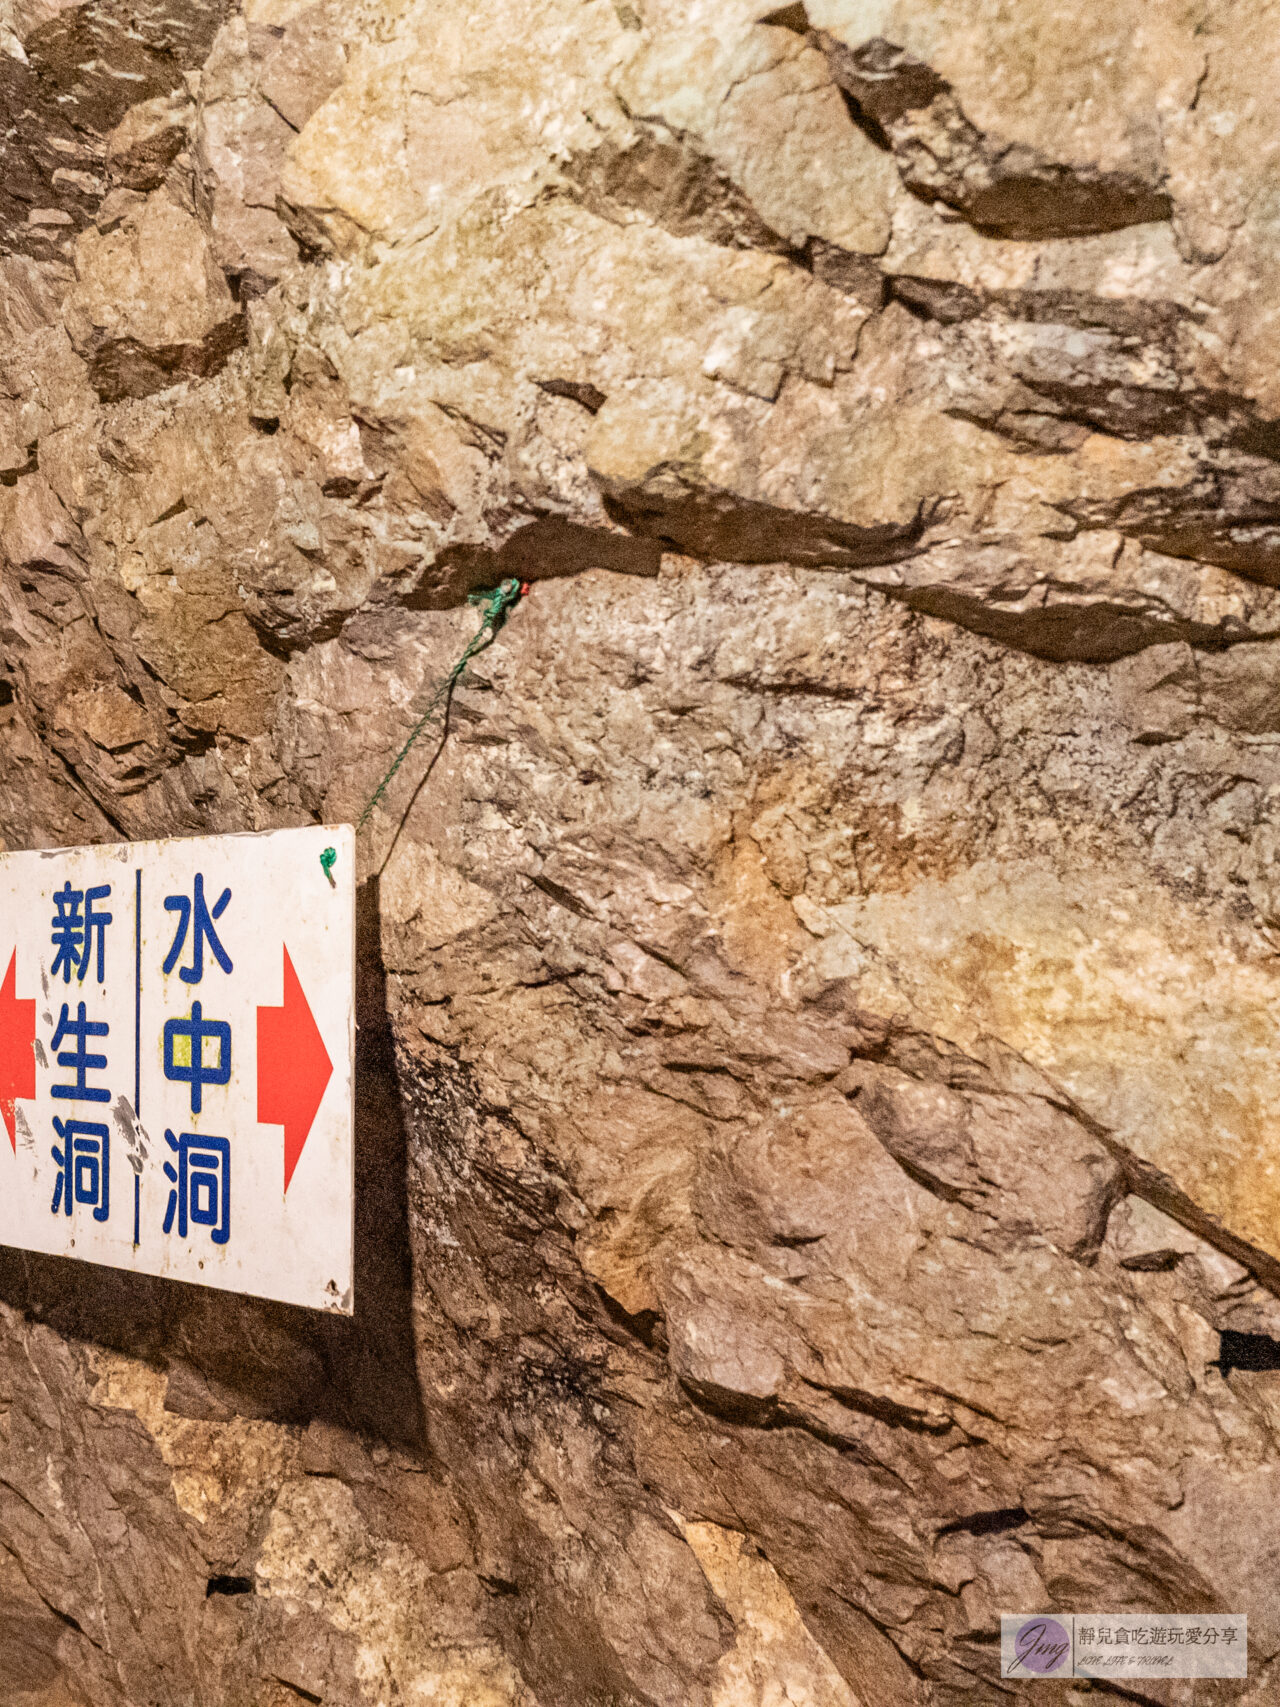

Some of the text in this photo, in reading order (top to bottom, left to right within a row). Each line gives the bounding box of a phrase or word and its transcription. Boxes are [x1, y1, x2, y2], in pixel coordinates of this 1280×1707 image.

[51, 880, 113, 1223] 新生洞
[162, 873, 233, 1245] 水中洞
